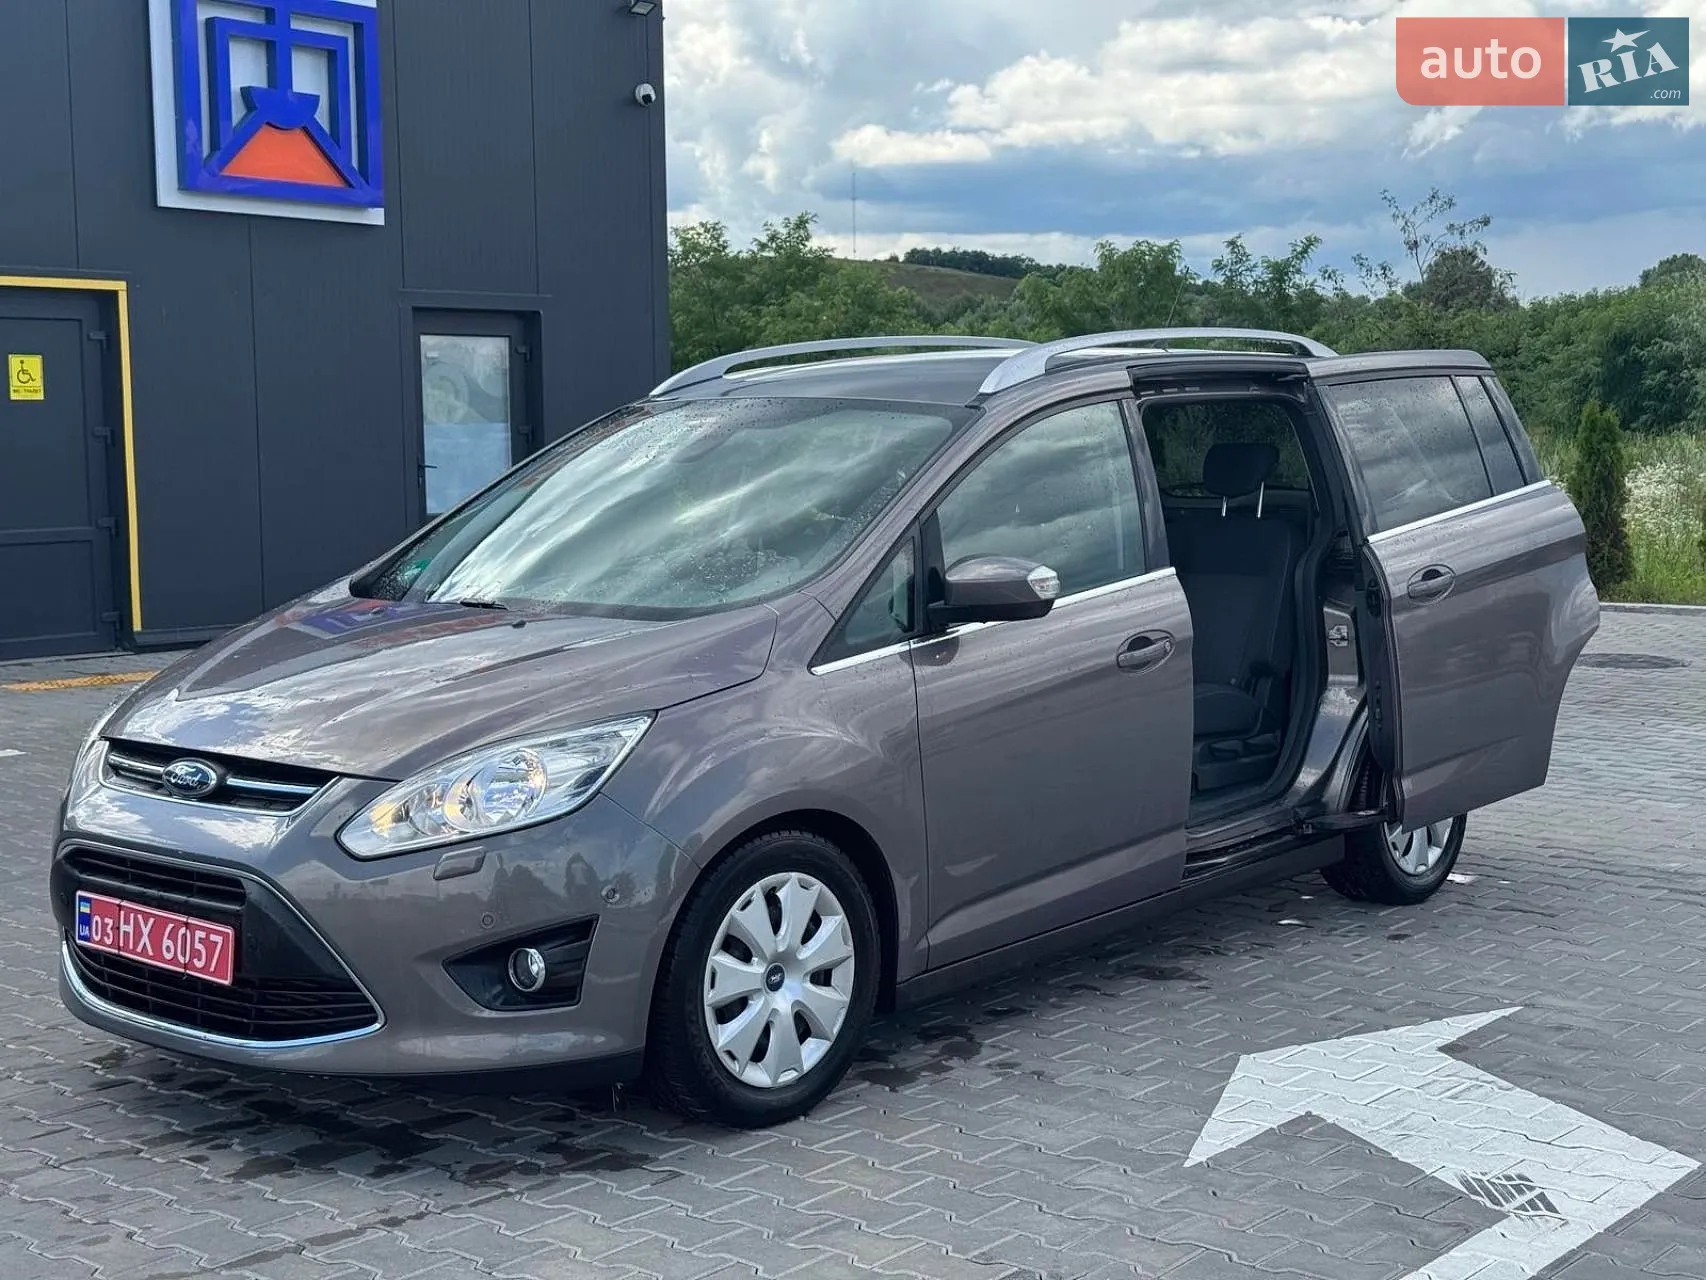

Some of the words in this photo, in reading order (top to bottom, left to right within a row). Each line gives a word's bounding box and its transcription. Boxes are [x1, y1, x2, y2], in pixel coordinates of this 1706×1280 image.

[171, 765, 203, 787] Ford
[79, 925, 90, 937] UA
[92, 914, 114, 945] 03
[119, 910, 155, 956] HX
[162, 923, 224, 973] 6057
